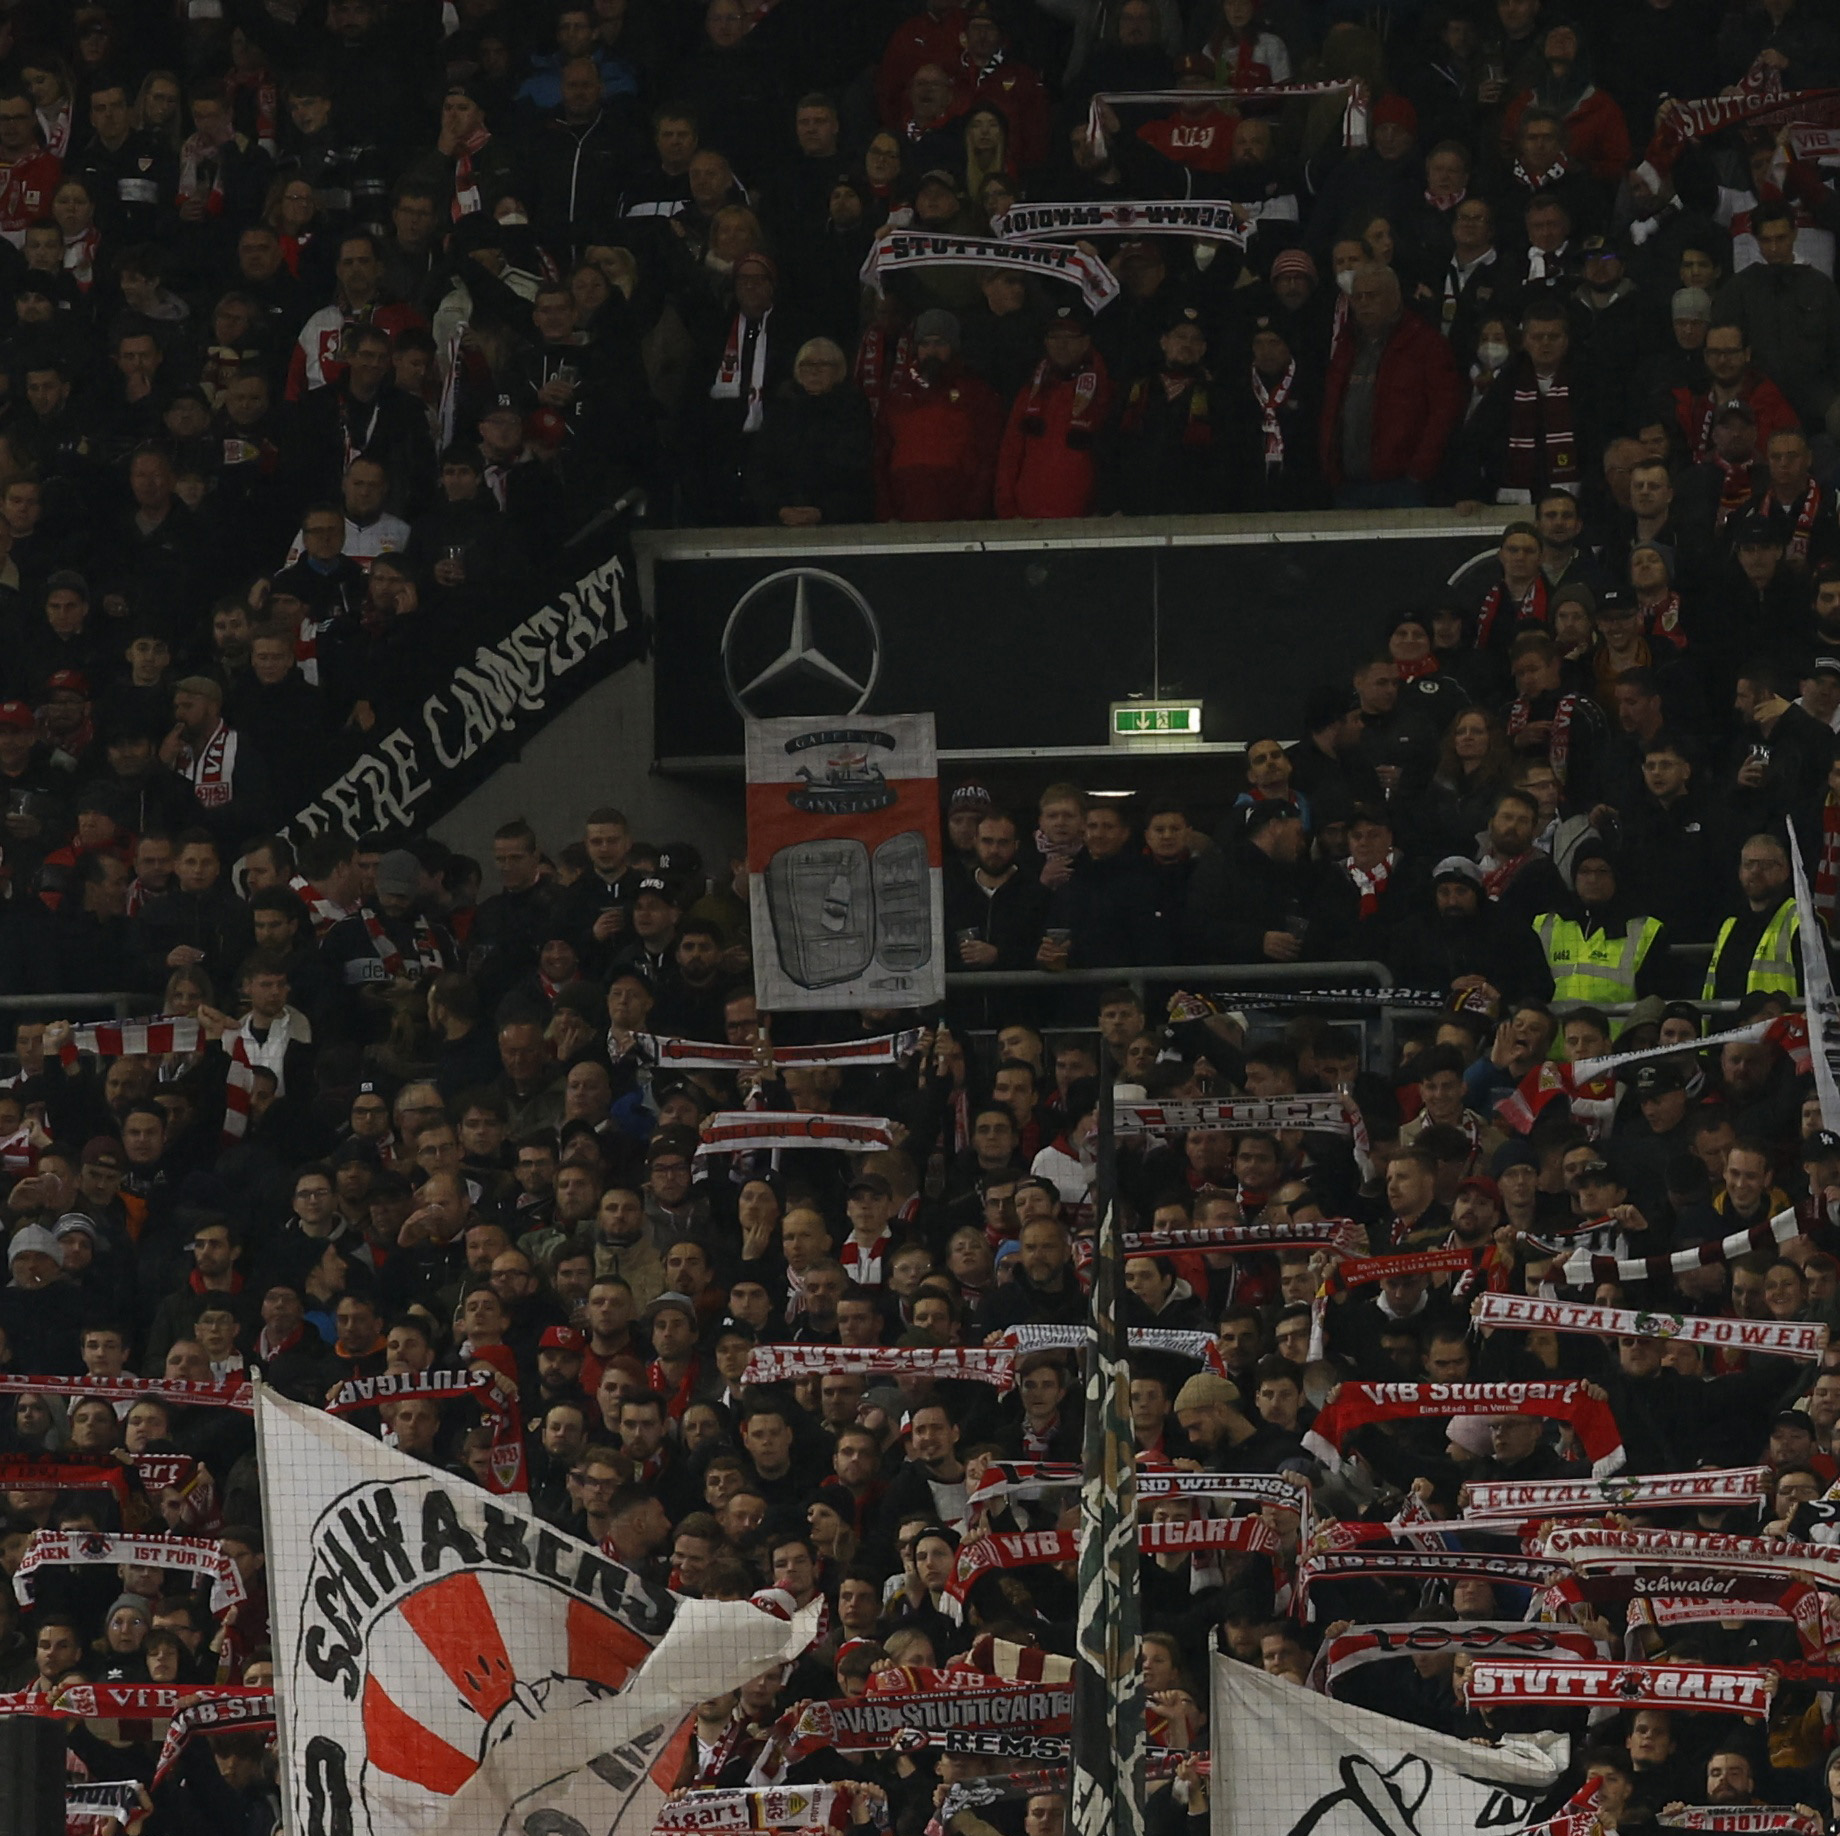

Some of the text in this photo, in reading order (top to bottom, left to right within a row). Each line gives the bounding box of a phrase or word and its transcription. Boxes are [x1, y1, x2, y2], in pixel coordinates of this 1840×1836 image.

[423, 554, 630, 770] CANNSTATT
[1481, 1301, 1818, 1351] LEINTAL POWER
[1367, 1381, 1581, 1407] VfB Stuttgart
[1647, 1474, 1762, 1499] POWER
[1001, 1530, 1062, 1560] VfB
[1551, 1525, 1746, 1553] CANNSTATTER
[108, 1688, 177, 1710] VfB
[1474, 1665, 1608, 1697] STUTT
[1663, 1669, 1766, 1706] GART
